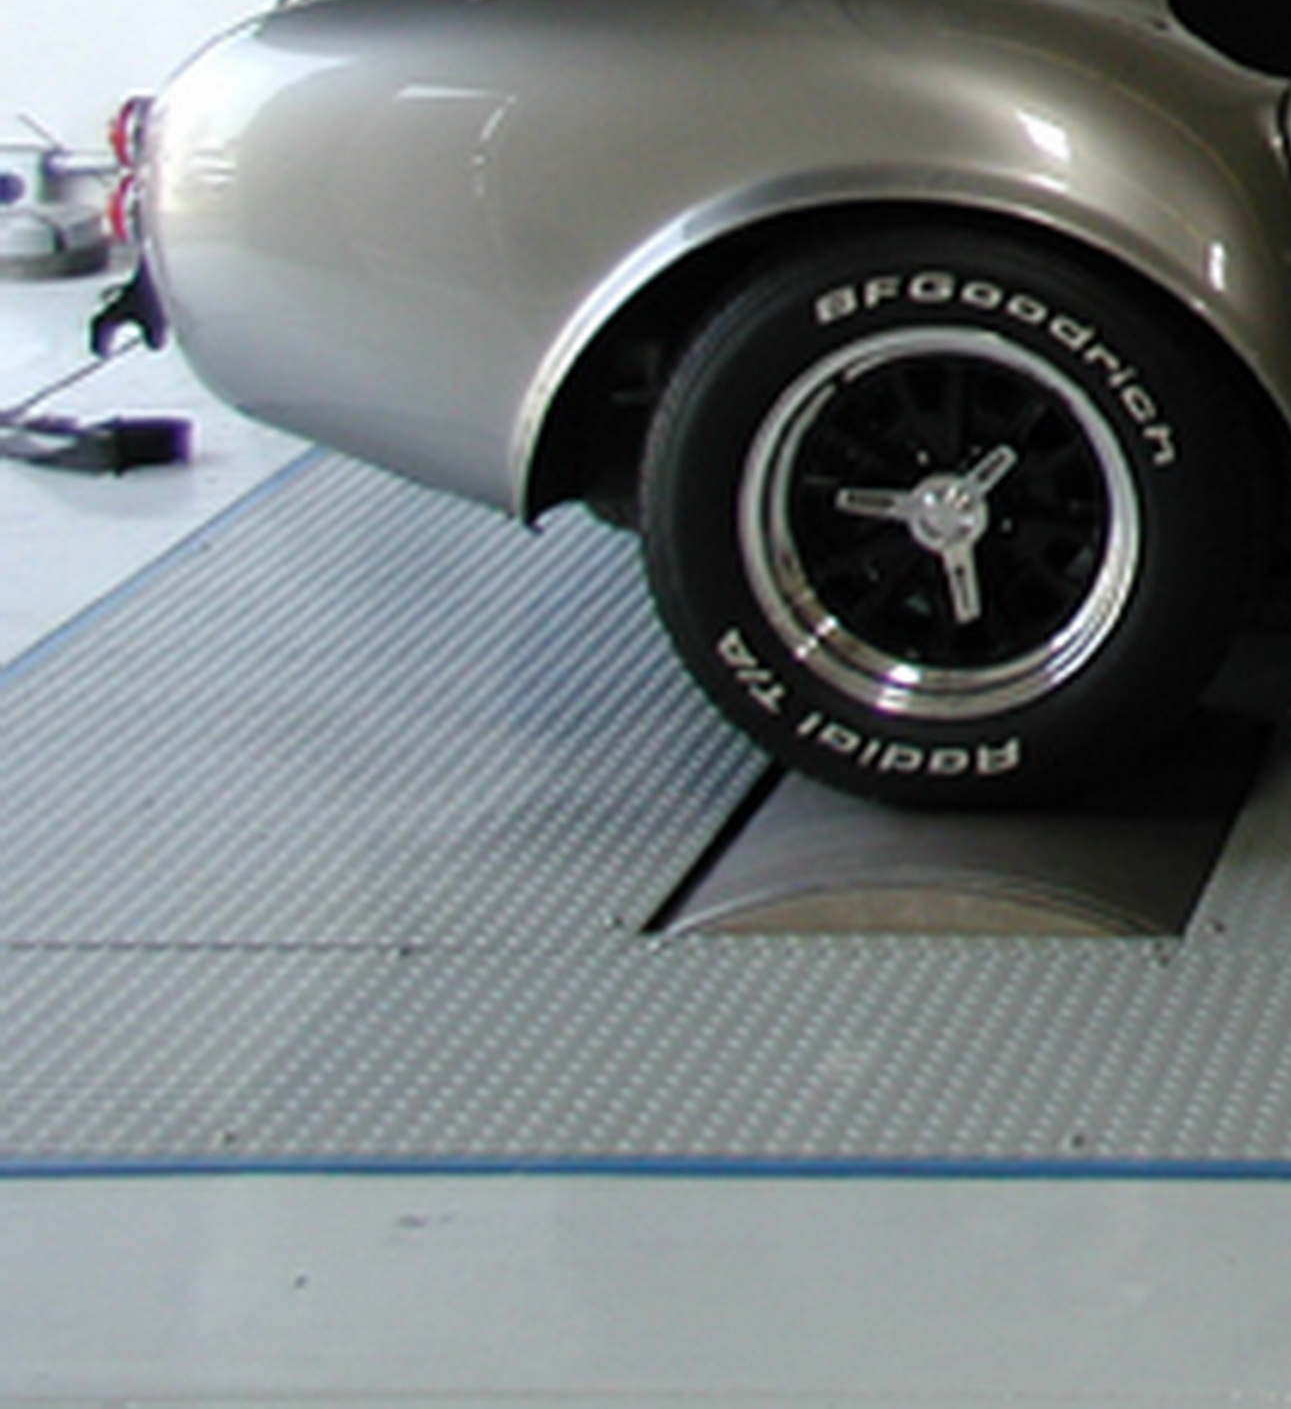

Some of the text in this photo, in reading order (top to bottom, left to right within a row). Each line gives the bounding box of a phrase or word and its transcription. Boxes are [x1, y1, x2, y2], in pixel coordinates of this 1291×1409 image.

[813, 271, 1178, 466] BFGoodrich
[717, 627, 1022, 775] Radial T/A
